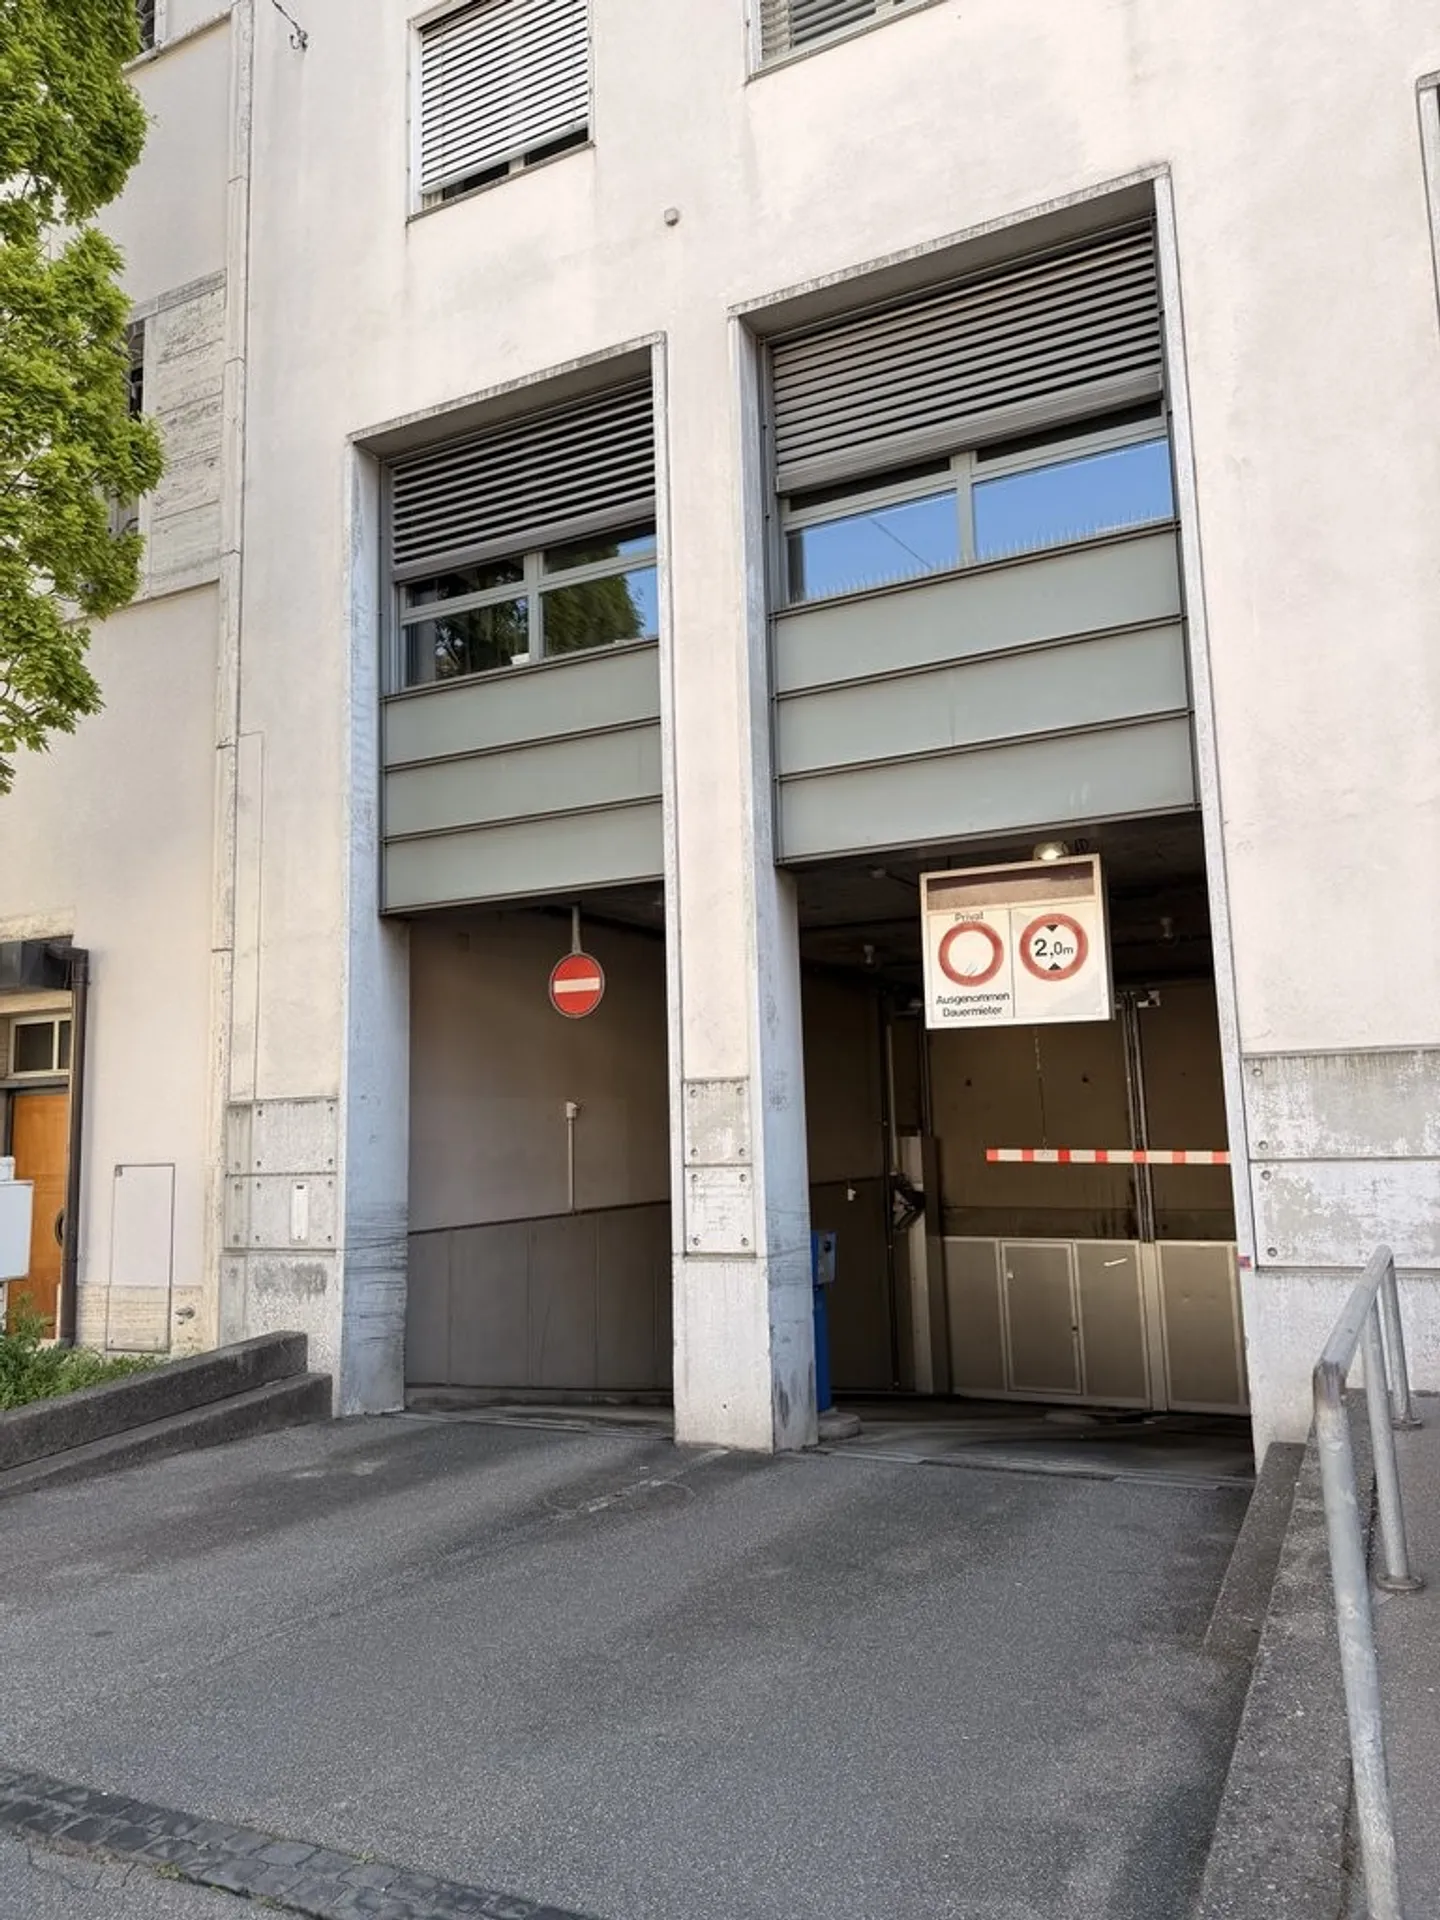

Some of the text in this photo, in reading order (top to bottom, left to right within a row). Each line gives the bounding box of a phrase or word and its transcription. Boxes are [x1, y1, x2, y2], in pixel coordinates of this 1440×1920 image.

[954, 911, 984, 922] Privat
[936, 992, 1010, 1006] Ausgenommen
[943, 1005, 1002, 1017] Dauermieter
